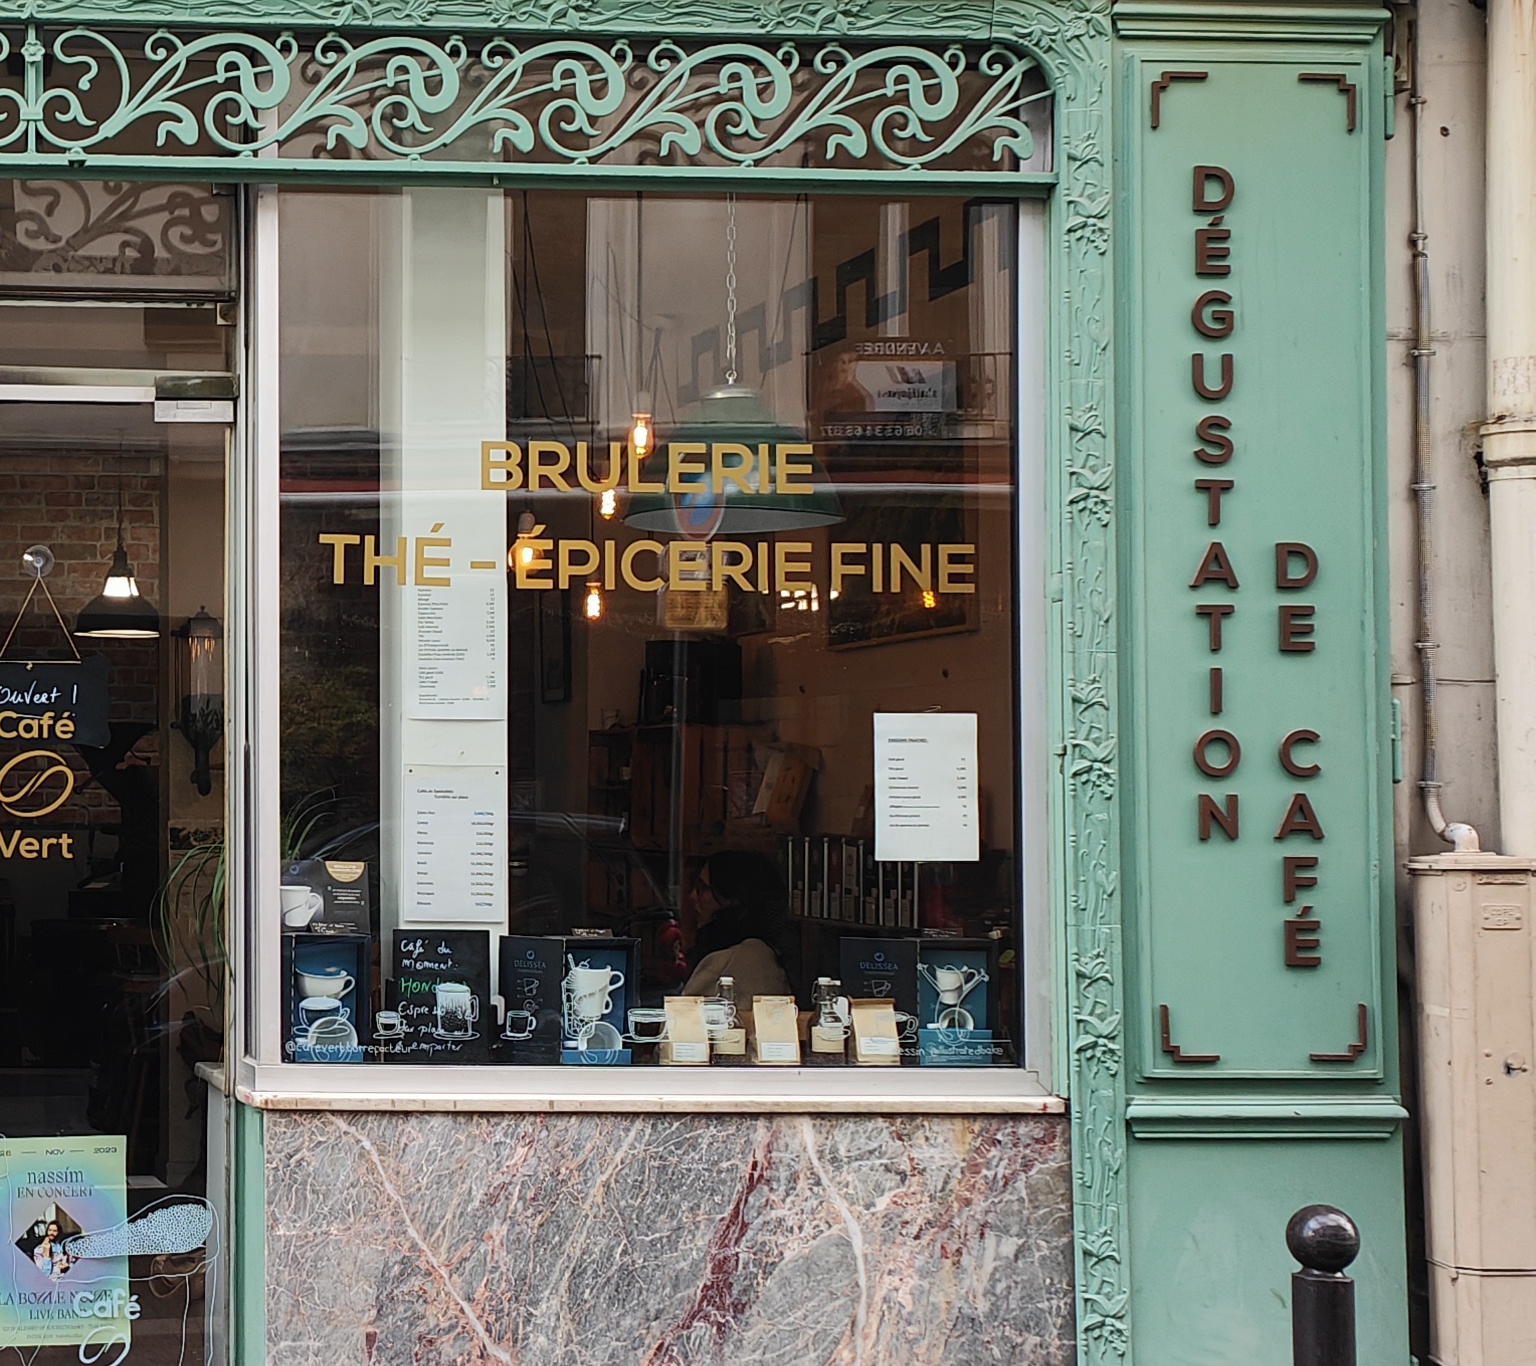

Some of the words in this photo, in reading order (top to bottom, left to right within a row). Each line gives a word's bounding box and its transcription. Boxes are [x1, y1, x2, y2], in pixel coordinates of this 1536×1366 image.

[480, 439, 815, 495] BRULERIE
[1189, 164, 1242, 843] DÉGUSTATION
[319, 522, 453, 588] THÉ
[516, 524, 814, 593] ÉPICERIE
[830, 542, 976, 595] FINE
[1275, 541, 1320, 654] DE
[1272, 727, 1325, 968] CAFÉ
[400, 938, 429, 959] Café
[437, 941, 453, 954] du
[45, 1148, 66, 1156] NOV
[17, 1186, 35, 1198] EN
[37, 1185, 95, 1199] CONCERT
[29, 1308, 55, 1321] LIVE
[57, 1308, 88, 1321] BAN
[72, 1288, 142, 1320] Café
